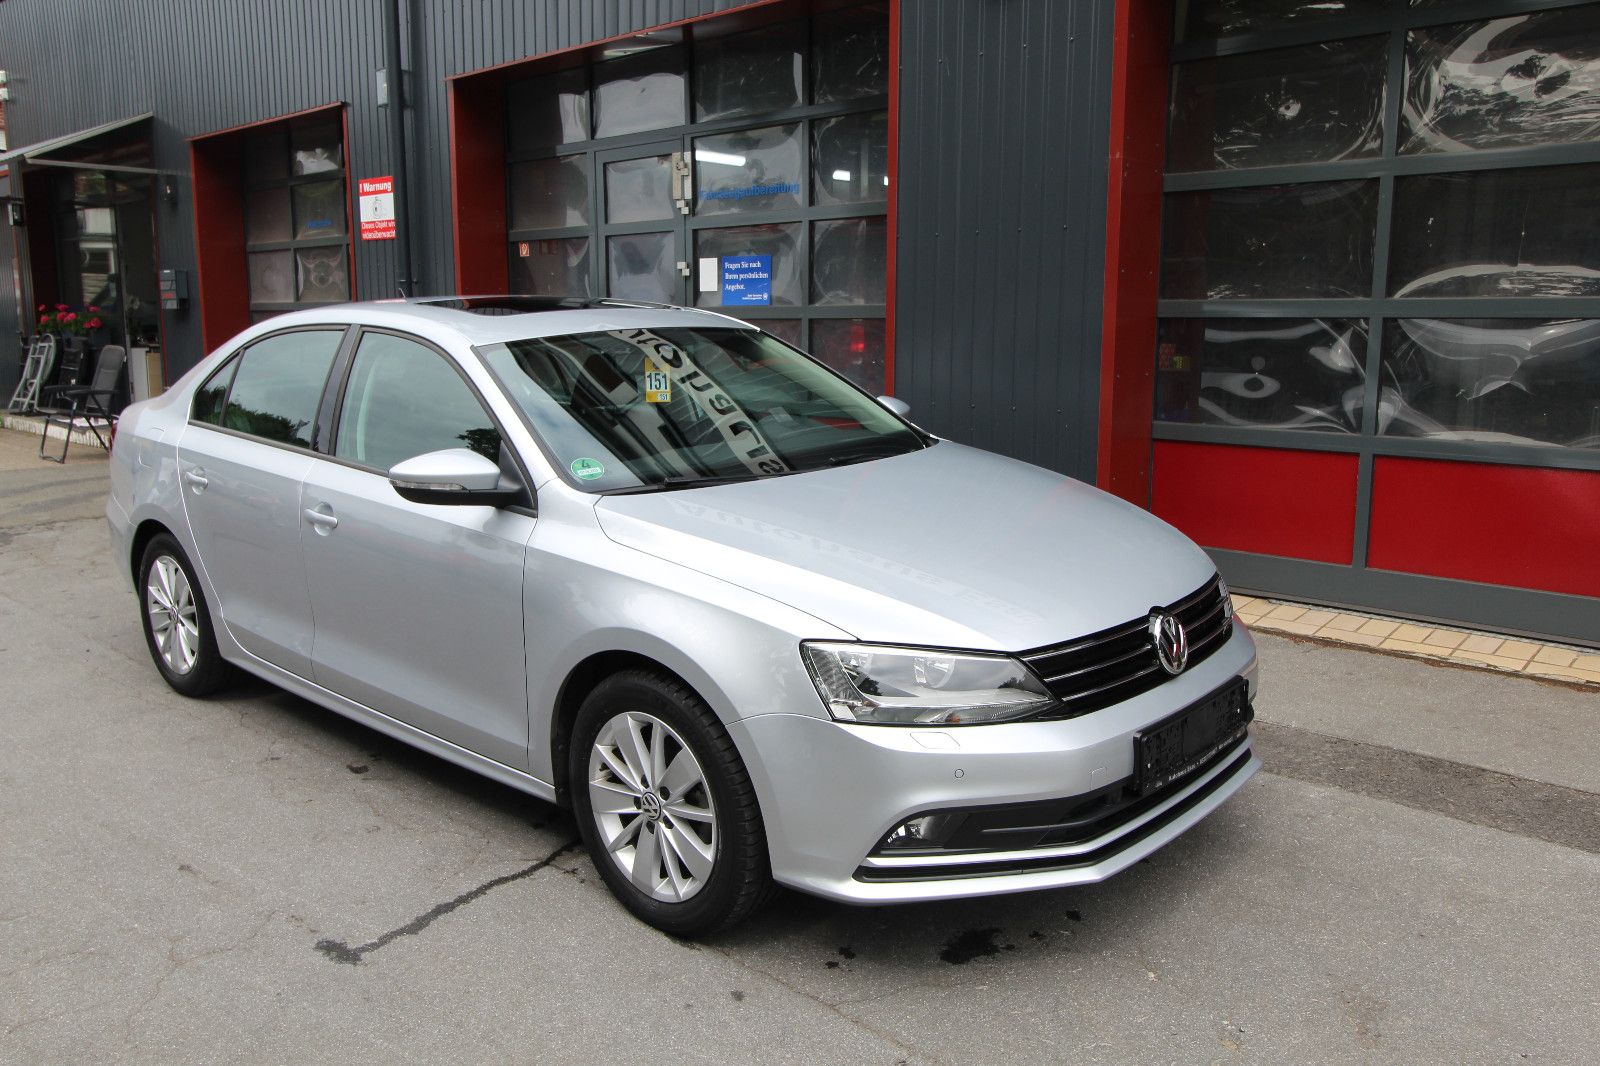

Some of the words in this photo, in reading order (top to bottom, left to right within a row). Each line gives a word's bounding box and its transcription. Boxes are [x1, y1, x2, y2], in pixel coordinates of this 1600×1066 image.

[363, 182, 391, 192] Warnung
[724, 262, 740, 271] Fragen
[741, 261, 749, 269] Sie
[750, 260, 762, 268] nach
[646, 372, 668, 391] 151
